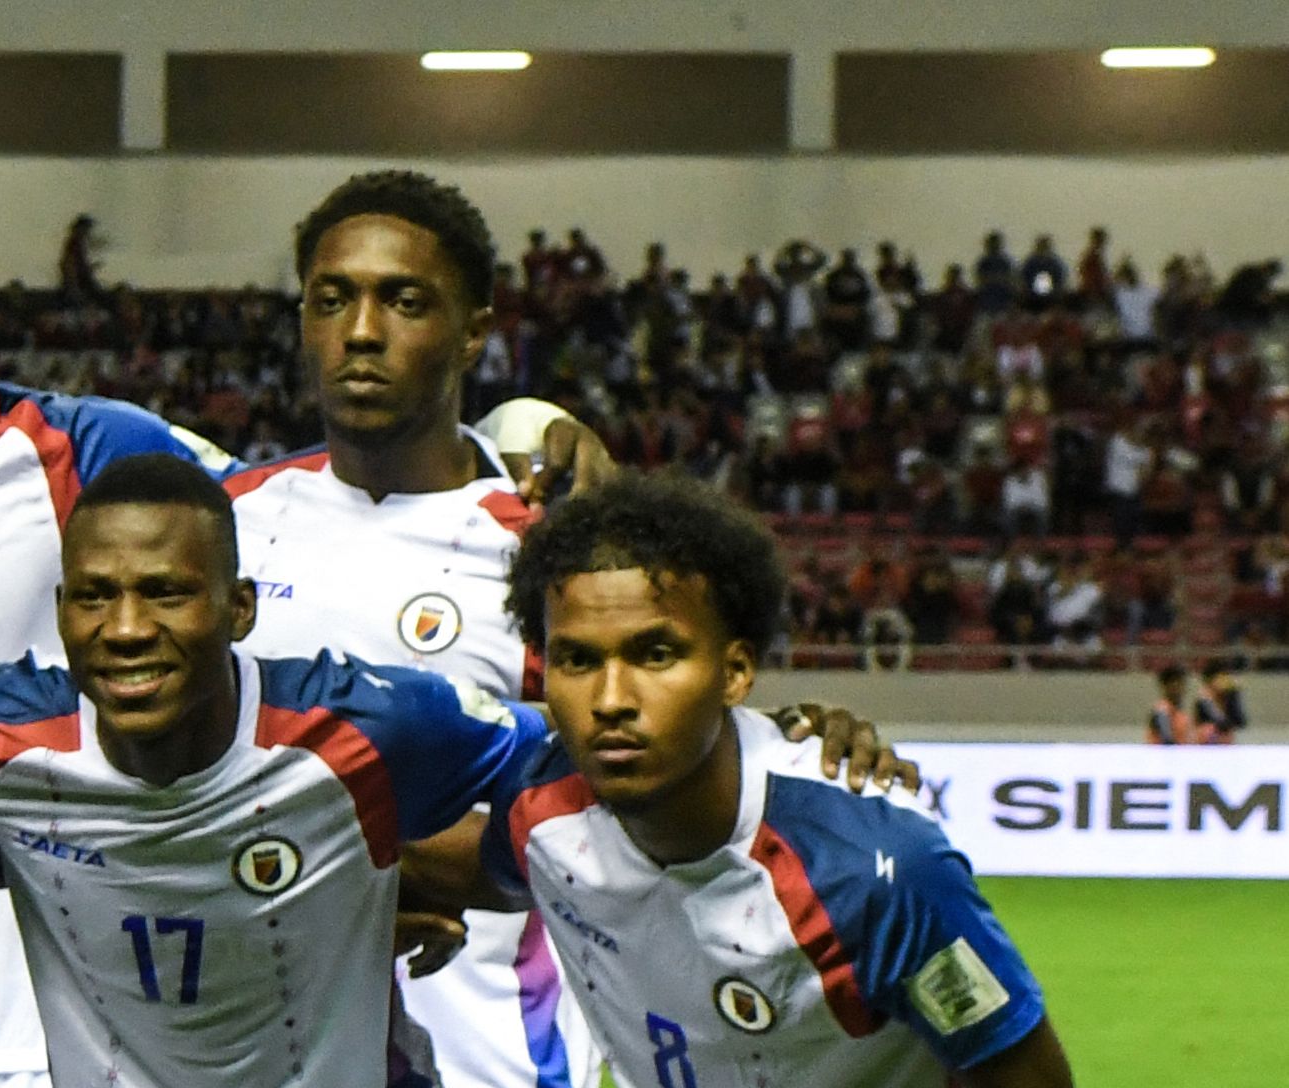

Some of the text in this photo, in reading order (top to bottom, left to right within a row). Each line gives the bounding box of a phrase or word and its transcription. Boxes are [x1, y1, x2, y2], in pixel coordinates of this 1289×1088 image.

[993, 779, 1282, 832] SIEM
[12, 830, 106, 868] SAETA
[121, 914, 205, 1004] 17
